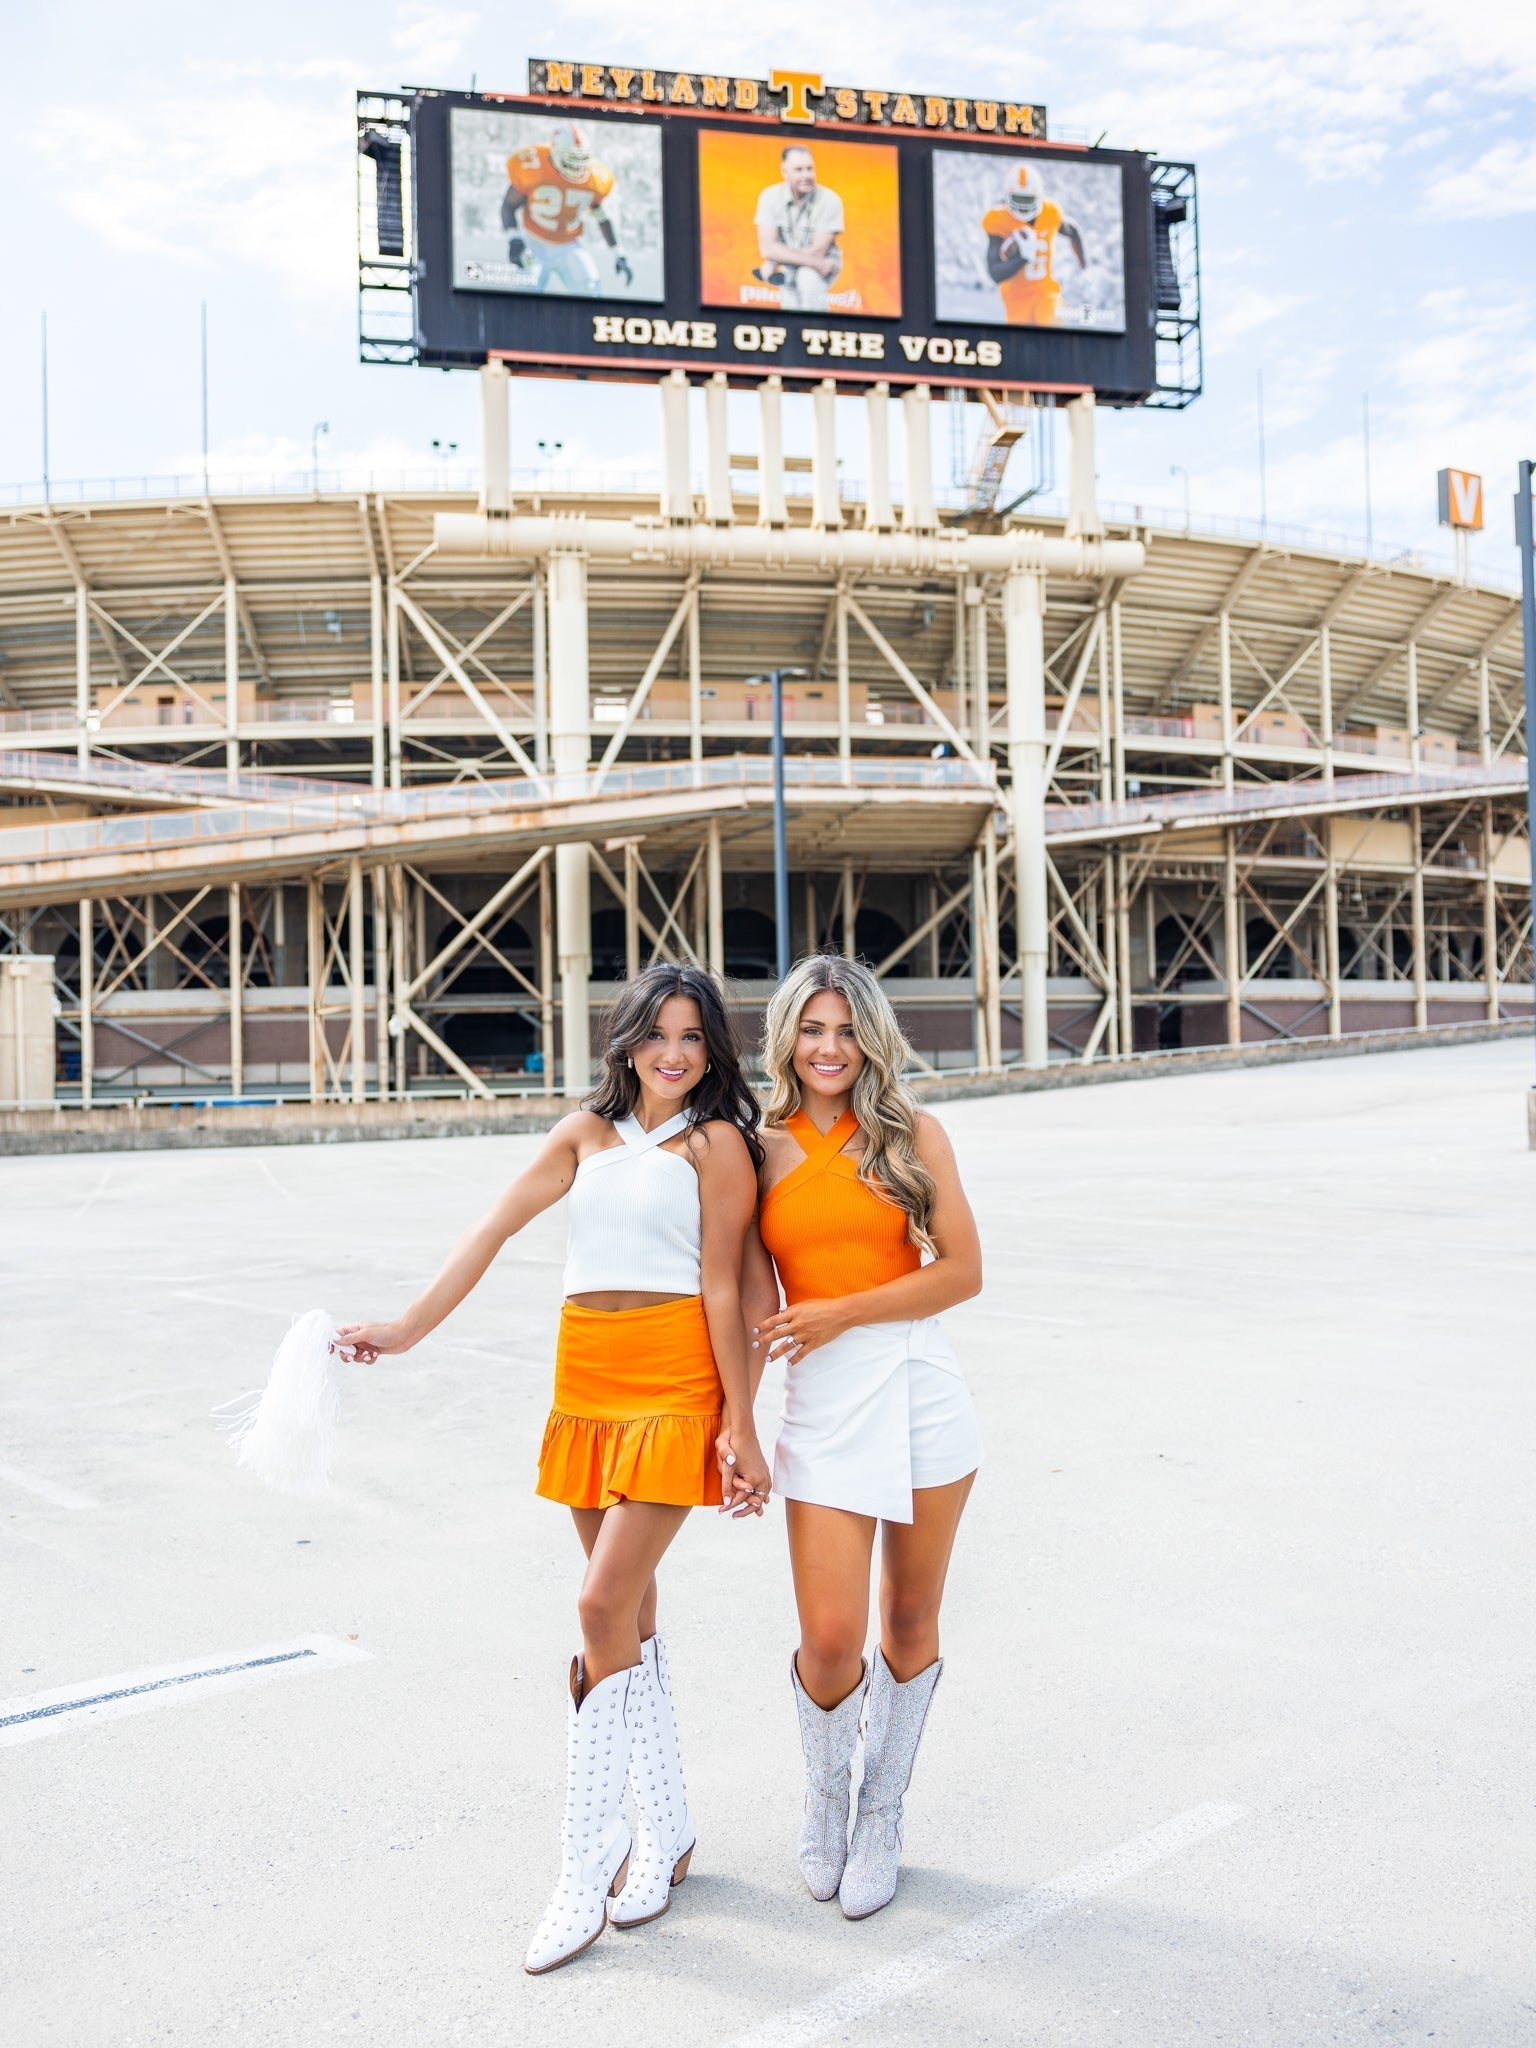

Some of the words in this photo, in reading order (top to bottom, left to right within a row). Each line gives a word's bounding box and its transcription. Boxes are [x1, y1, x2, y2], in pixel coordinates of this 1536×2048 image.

[546, 61, 759, 109] NEYLAND
[768, 68, 826, 125] T
[835, 89, 1034, 134] STADIUM
[529, 184, 595, 232] 27
[593, 316, 717, 349] HOME
[733, 324, 787, 352] OF
[802, 328, 885, 359] THE
[899, 335, 1002, 367] VOLS
[1450, 471, 1481, 523] V
